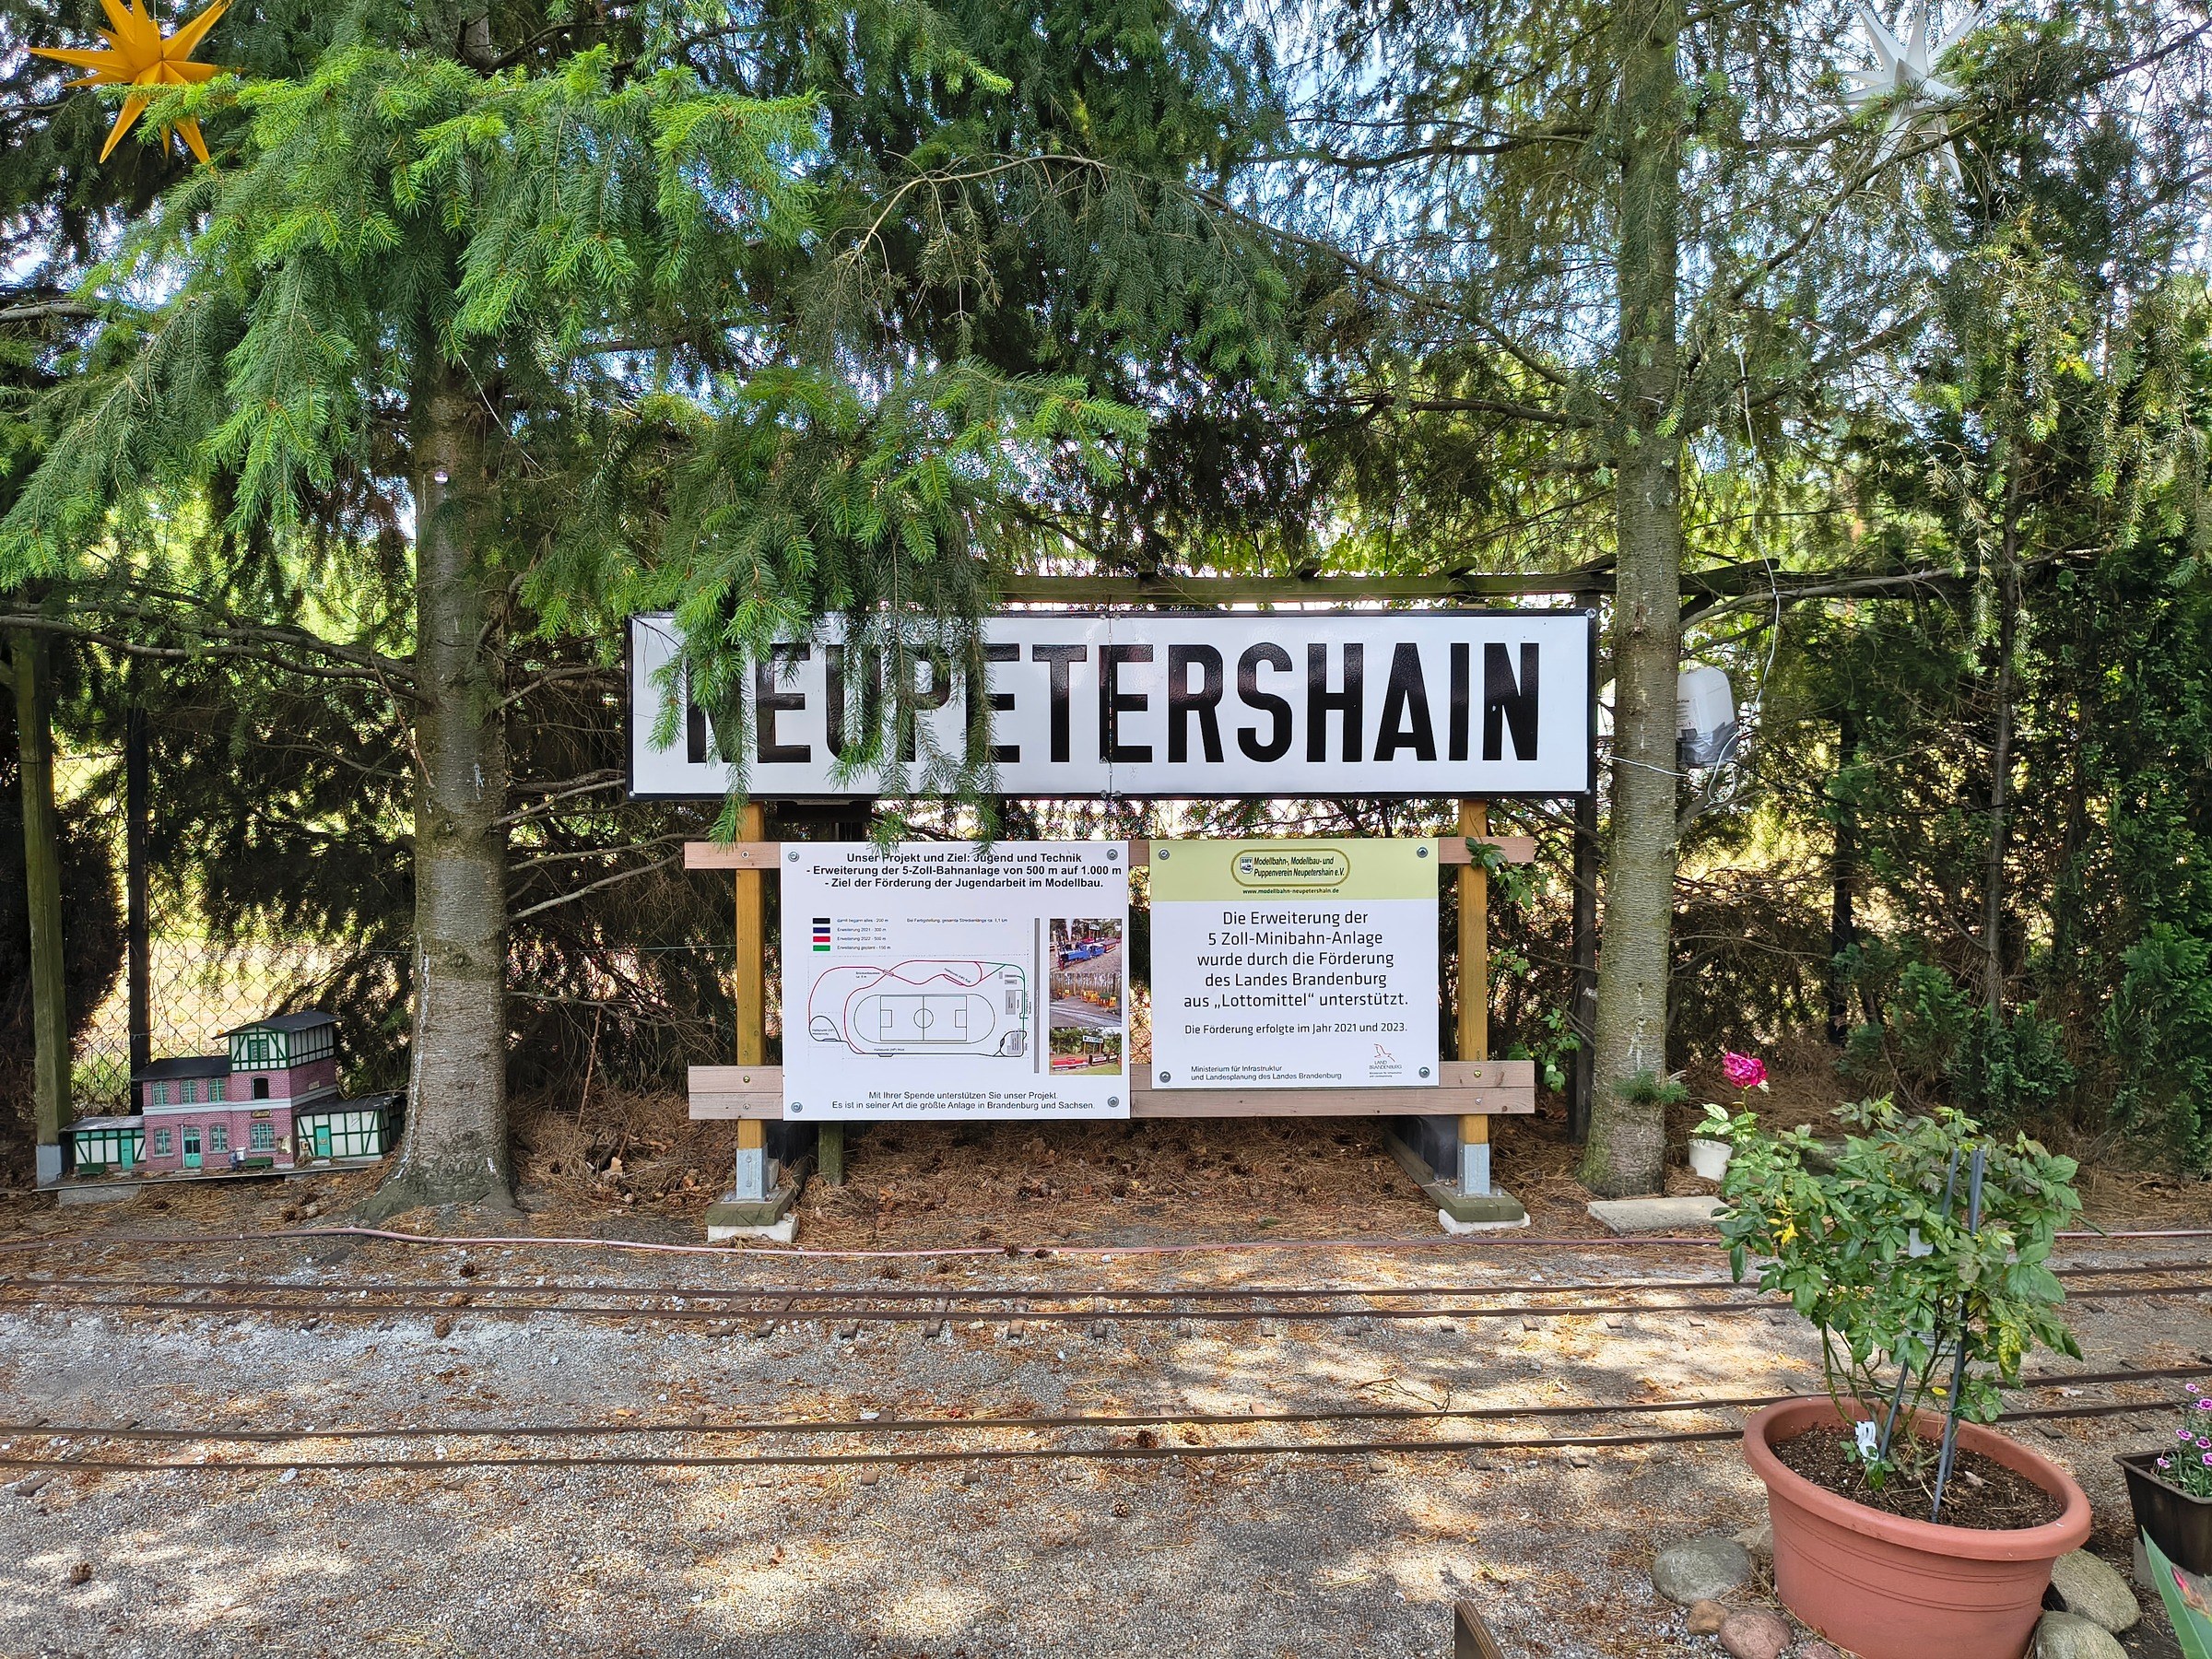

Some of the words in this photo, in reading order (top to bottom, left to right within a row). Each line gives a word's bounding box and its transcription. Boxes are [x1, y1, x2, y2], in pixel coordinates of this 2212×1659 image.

[847, 853, 879, 863] Unser
[882, 853, 921, 865] Projekt
[924, 853, 944, 863] und
[947, 853, 971, 863] Ziel:
[973, 853, 1014, 865] Jugend
[1017, 853, 1037, 863] und
[1040, 853, 1082, 863] Technik
[1323, 856, 1335, 865] und
[813, 865, 878, 877] Erweiterung
[881, 865, 900, 875] der
[902, 865, 1000, 877] 5-Zoll-Bahnanlage
[1026, 865, 1045, 875] 500
[1061, 865, 1078, 875] auf
[1081, 865, 1109, 875] 1.000
[1253, 867, 1292, 878] Puppenverein
[1293, 867, 1334, 878] Neupetershain
[1335, 867, 1345, 877] e.V.
[831, 878, 851, 888] Ziel
[854, 878, 872, 888] der
[875, 878, 931, 889] Förderung
[935, 878, 952, 888] der
[955, 877, 1026, 889] Jugendarbeit
[1030, 878, 1041, 888] im
[1045, 878, 1103, 888] Modellbau.
[1223, 912, 1246, 924] Die
[1251, 911, 1340, 927] Erweiterung
[1345, 910, 1368, 924] der
[1208, 933, 1217, 946] 5
[1221, 931, 1382, 947] Zoll-Minibahn-Anlage
[1197, 952, 1242, 966] wurde
[1247, 952, 1288, 966] durch
[1293, 951, 1314, 965] die
[1319, 951, 1394, 968] Förderung
[1206, 973, 1230, 987] des
[1236, 972, 1288, 986] Landes
[1293, 971, 1386, 988] Brandenburg
[1184, 997, 1209, 1007] aus
[1215, 993, 1314, 1009] „Lottomittel“
[1320, 993, 1407, 1006] unterstützt.
[1185, 1025, 1201, 1034] Die
[1204, 1024, 1253, 1036] Förderung
[1256, 1023, 1295, 1036] erfolgte
[1298, 1023, 1310, 1033] im
[1312, 1023, 1332, 1035] Jahr
[1335, 1023, 1357, 1032] 2021
[1359, 1022, 1378, 1032] und
[1381, 1022, 1407, 1031] 2023.
[1206, 1073, 1257, 1082] Landesplanung
[1299, 1073, 1342, 1081] Brandenburg
[883, 1091, 901, 1100] Ihrer
[904, 1091, 935, 1100] Spende
[936, 1091, 986, 1100] unterstützen
[988, 1091, 1002, 1100] Sie
[832, 1100, 843, 1109] Es
[920, 1101, 946, 1111] größte
[947, 1101, 976, 1111] Anlage
[987, 1101, 1039, 1111] Brandenburg
